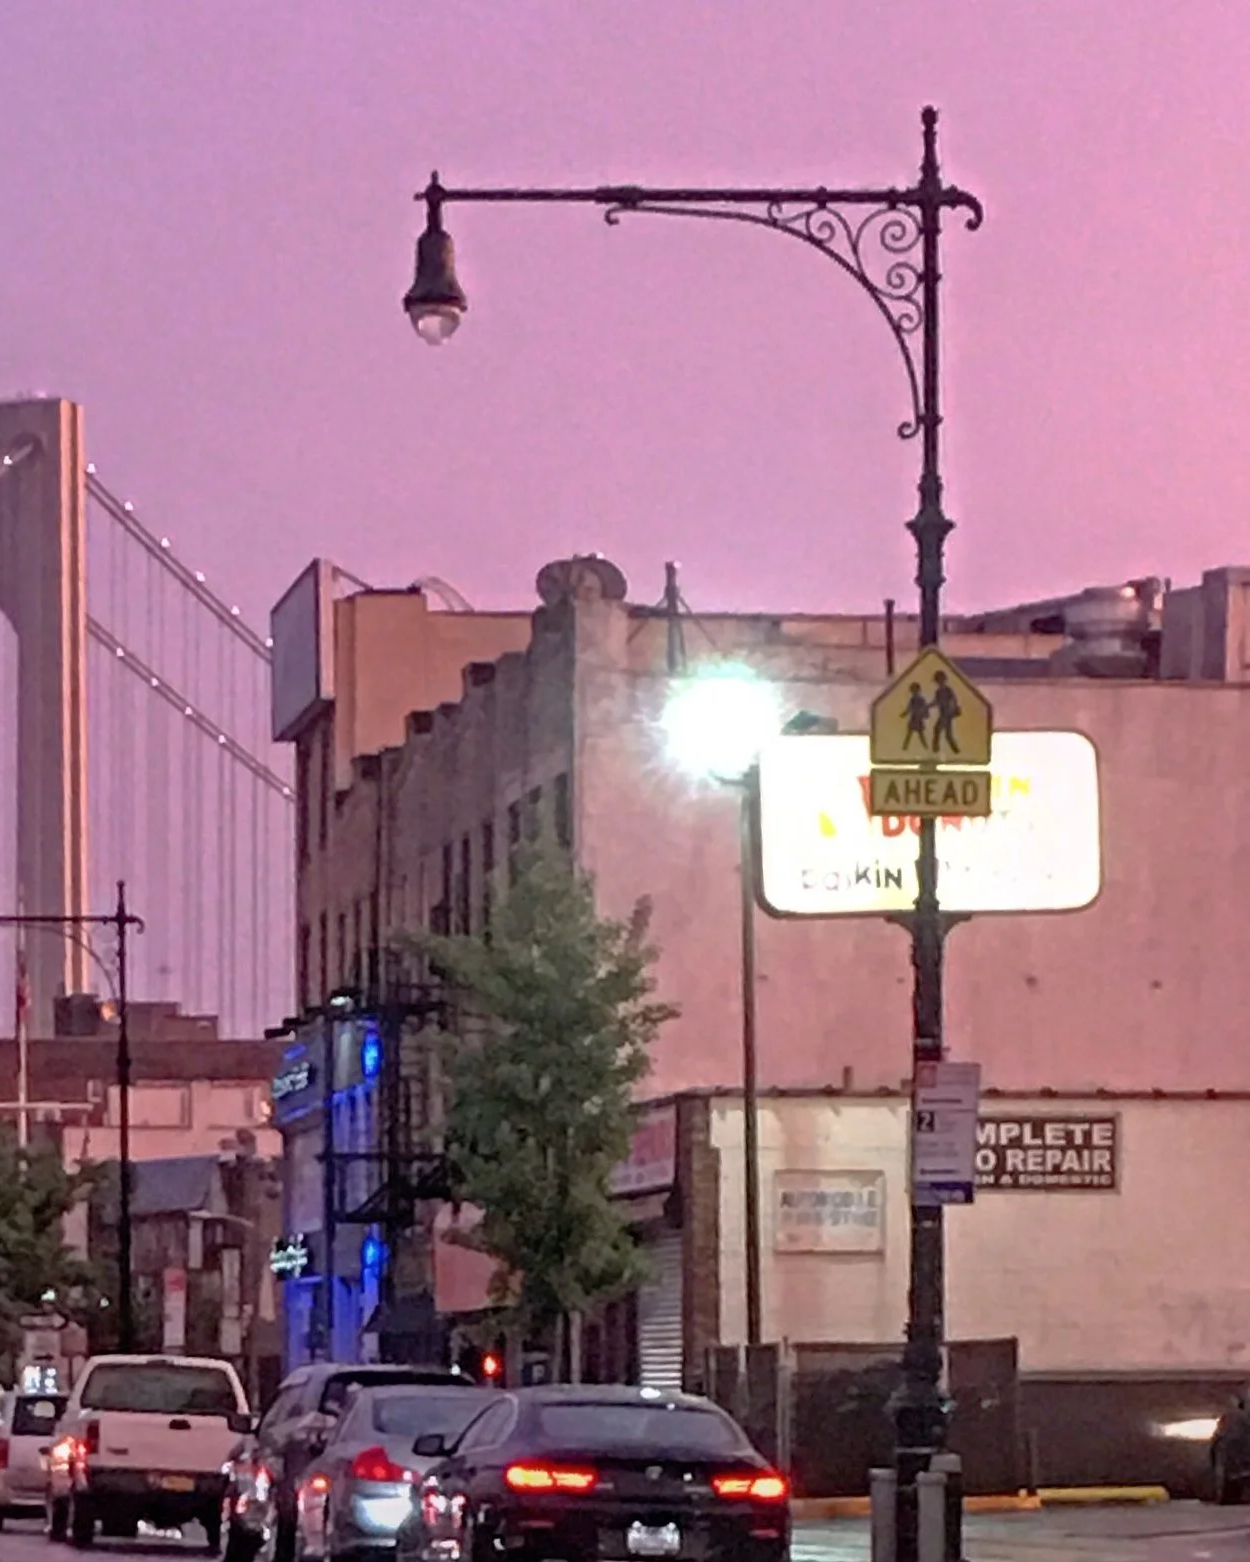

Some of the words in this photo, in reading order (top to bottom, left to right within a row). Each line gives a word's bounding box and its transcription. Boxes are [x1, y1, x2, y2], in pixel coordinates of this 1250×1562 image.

[883, 779, 979, 806] AHEAD
[976, 1121, 1114, 1146] MPLETE
[1006, 1148, 1112, 1172] REPAIR
